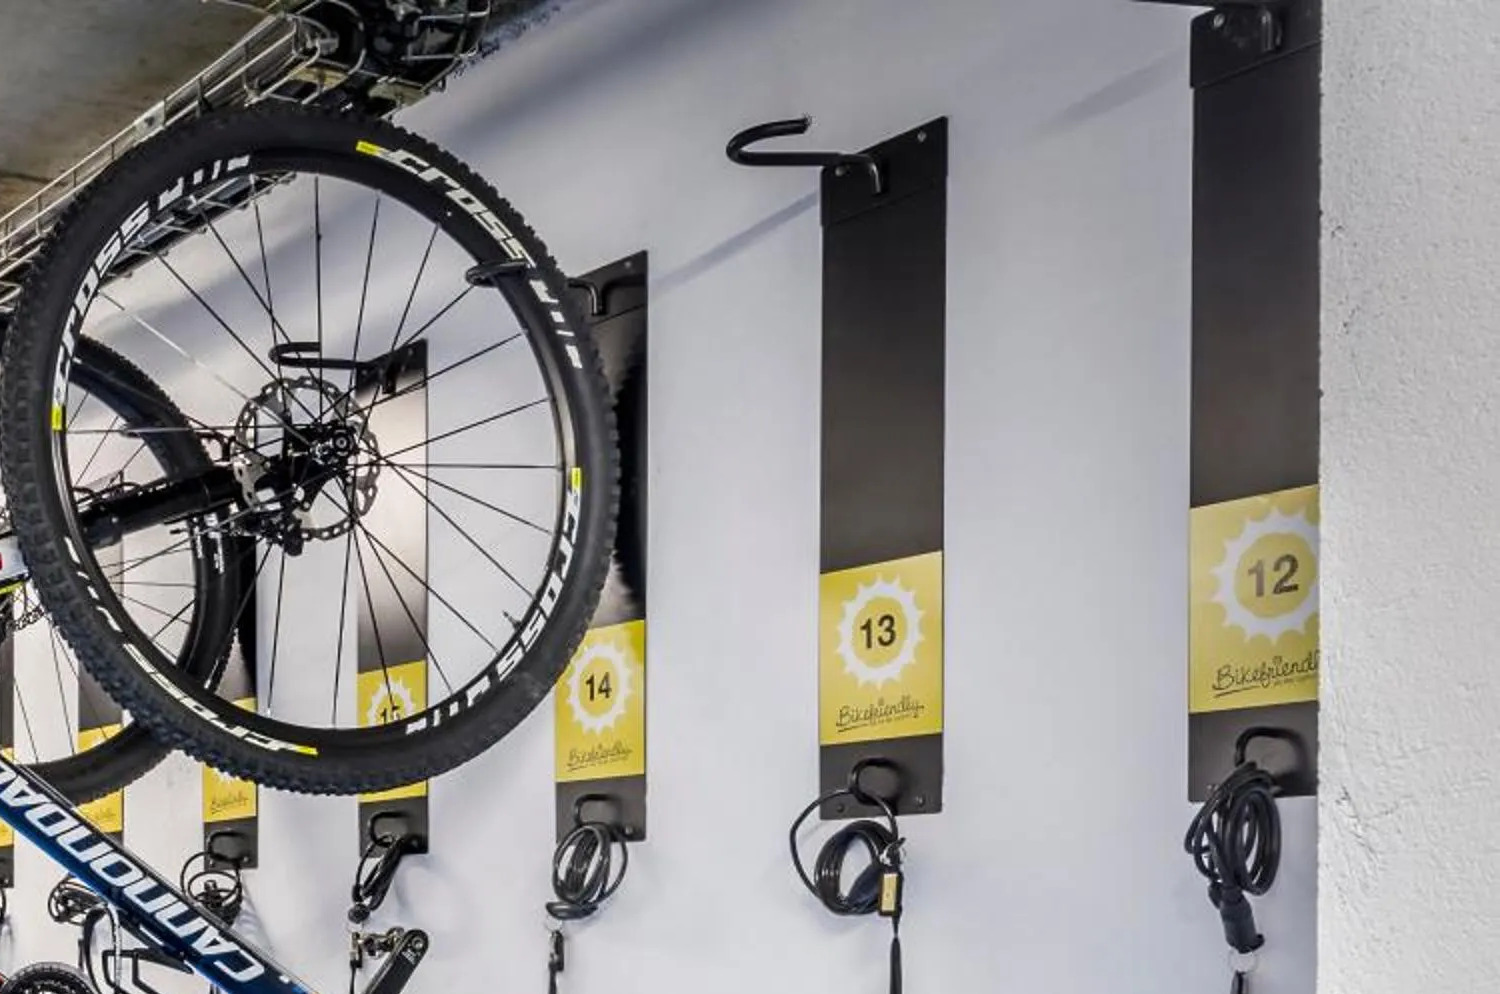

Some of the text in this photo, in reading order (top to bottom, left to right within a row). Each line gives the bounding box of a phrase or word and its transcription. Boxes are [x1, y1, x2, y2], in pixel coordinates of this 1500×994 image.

[1247, 554, 1299, 598] 12
[860, 614, 896, 649] 13
[585, 671, 613, 701] 14
[1212, 649, 1319, 691] Bikefriendl
[836, 695, 925, 731] Bikefriendly
